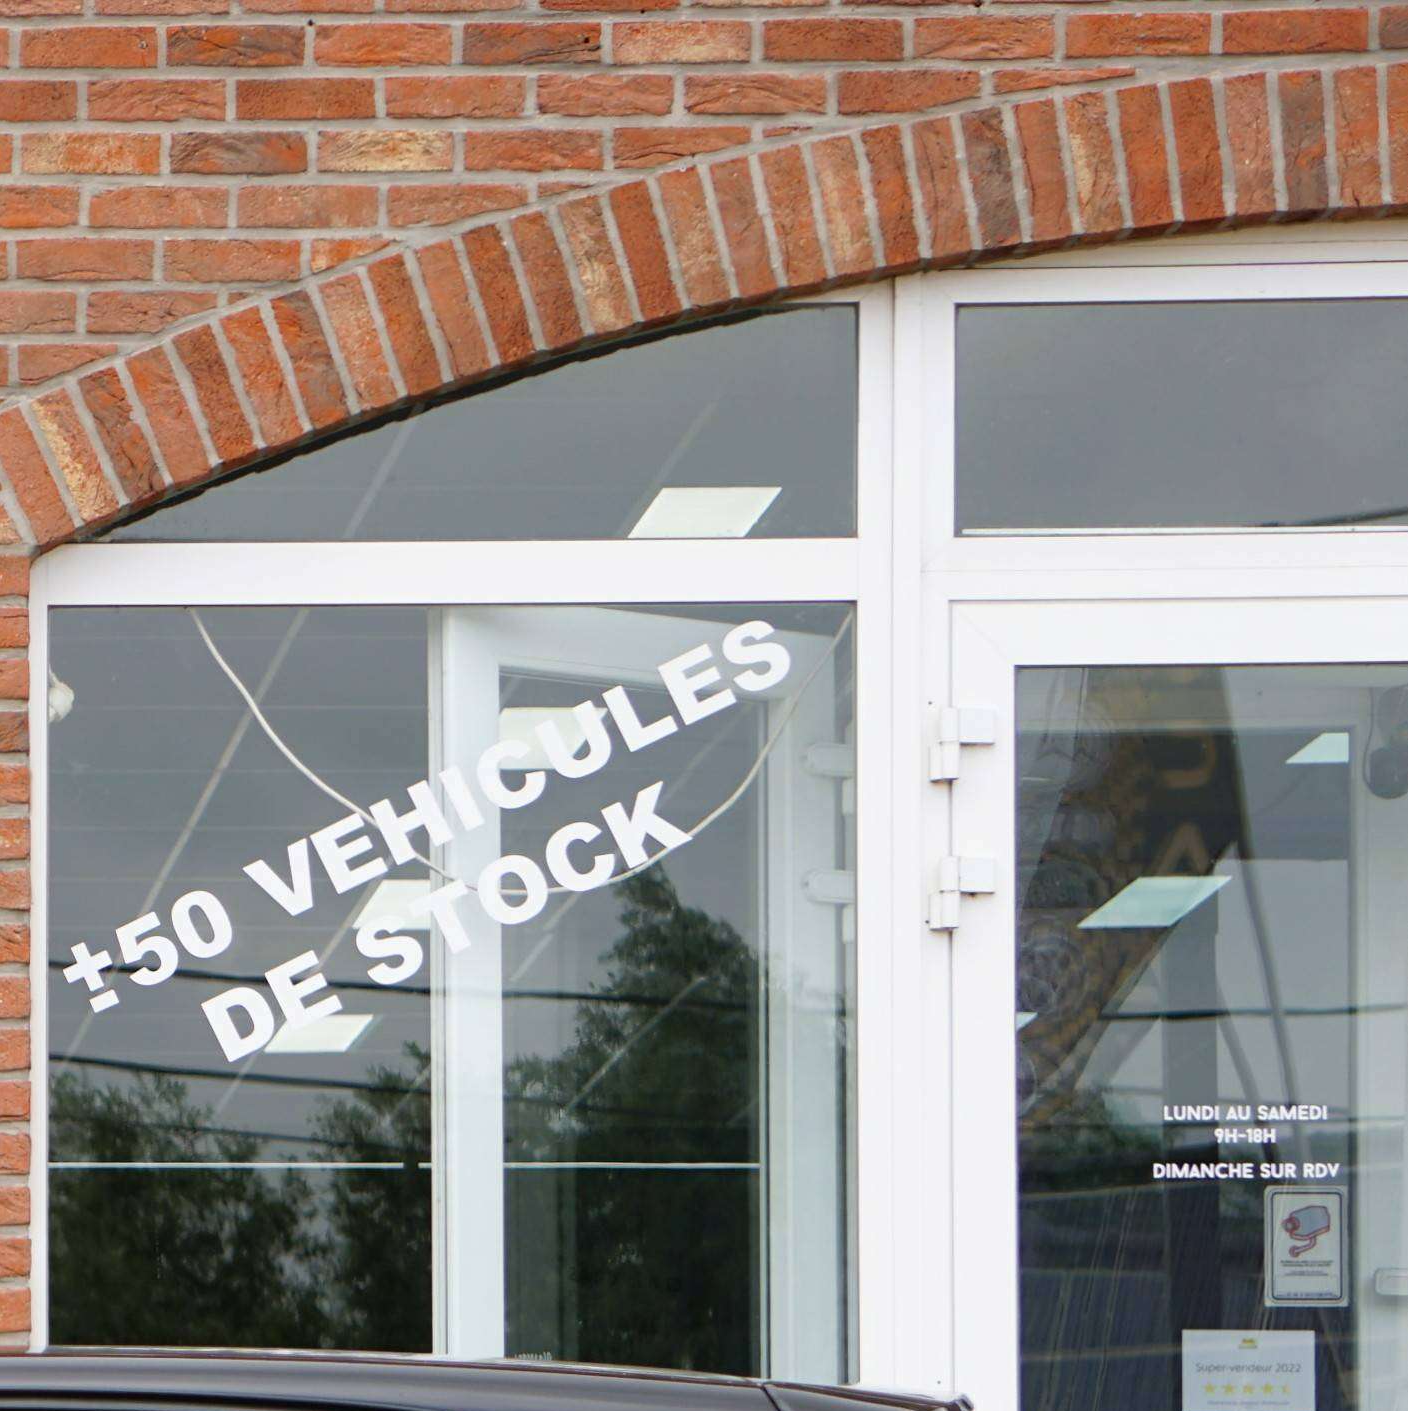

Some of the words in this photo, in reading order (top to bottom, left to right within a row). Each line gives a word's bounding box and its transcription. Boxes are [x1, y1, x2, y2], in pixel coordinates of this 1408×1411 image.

[243, 619, 792, 917] VEHICULES
[200, 949, 344, 1063] DE
[354, 780, 694, 987] STOCK
[1163, 1105, 1220, 1121] LUNDI
[1225, 1105, 1251, 1121] AU
[1257, 1104, 1328, 1121] SAMEDI
[1214, 1127, 1277, 1143] 9H-18H
[1152, 1162, 1254, 1179] DIMANCHE
[1259, 1162, 1297, 1179] SUR
[1302, 1162, 1340, 1179] RDV
[1275, 1362, 1302, 1373] 2022
